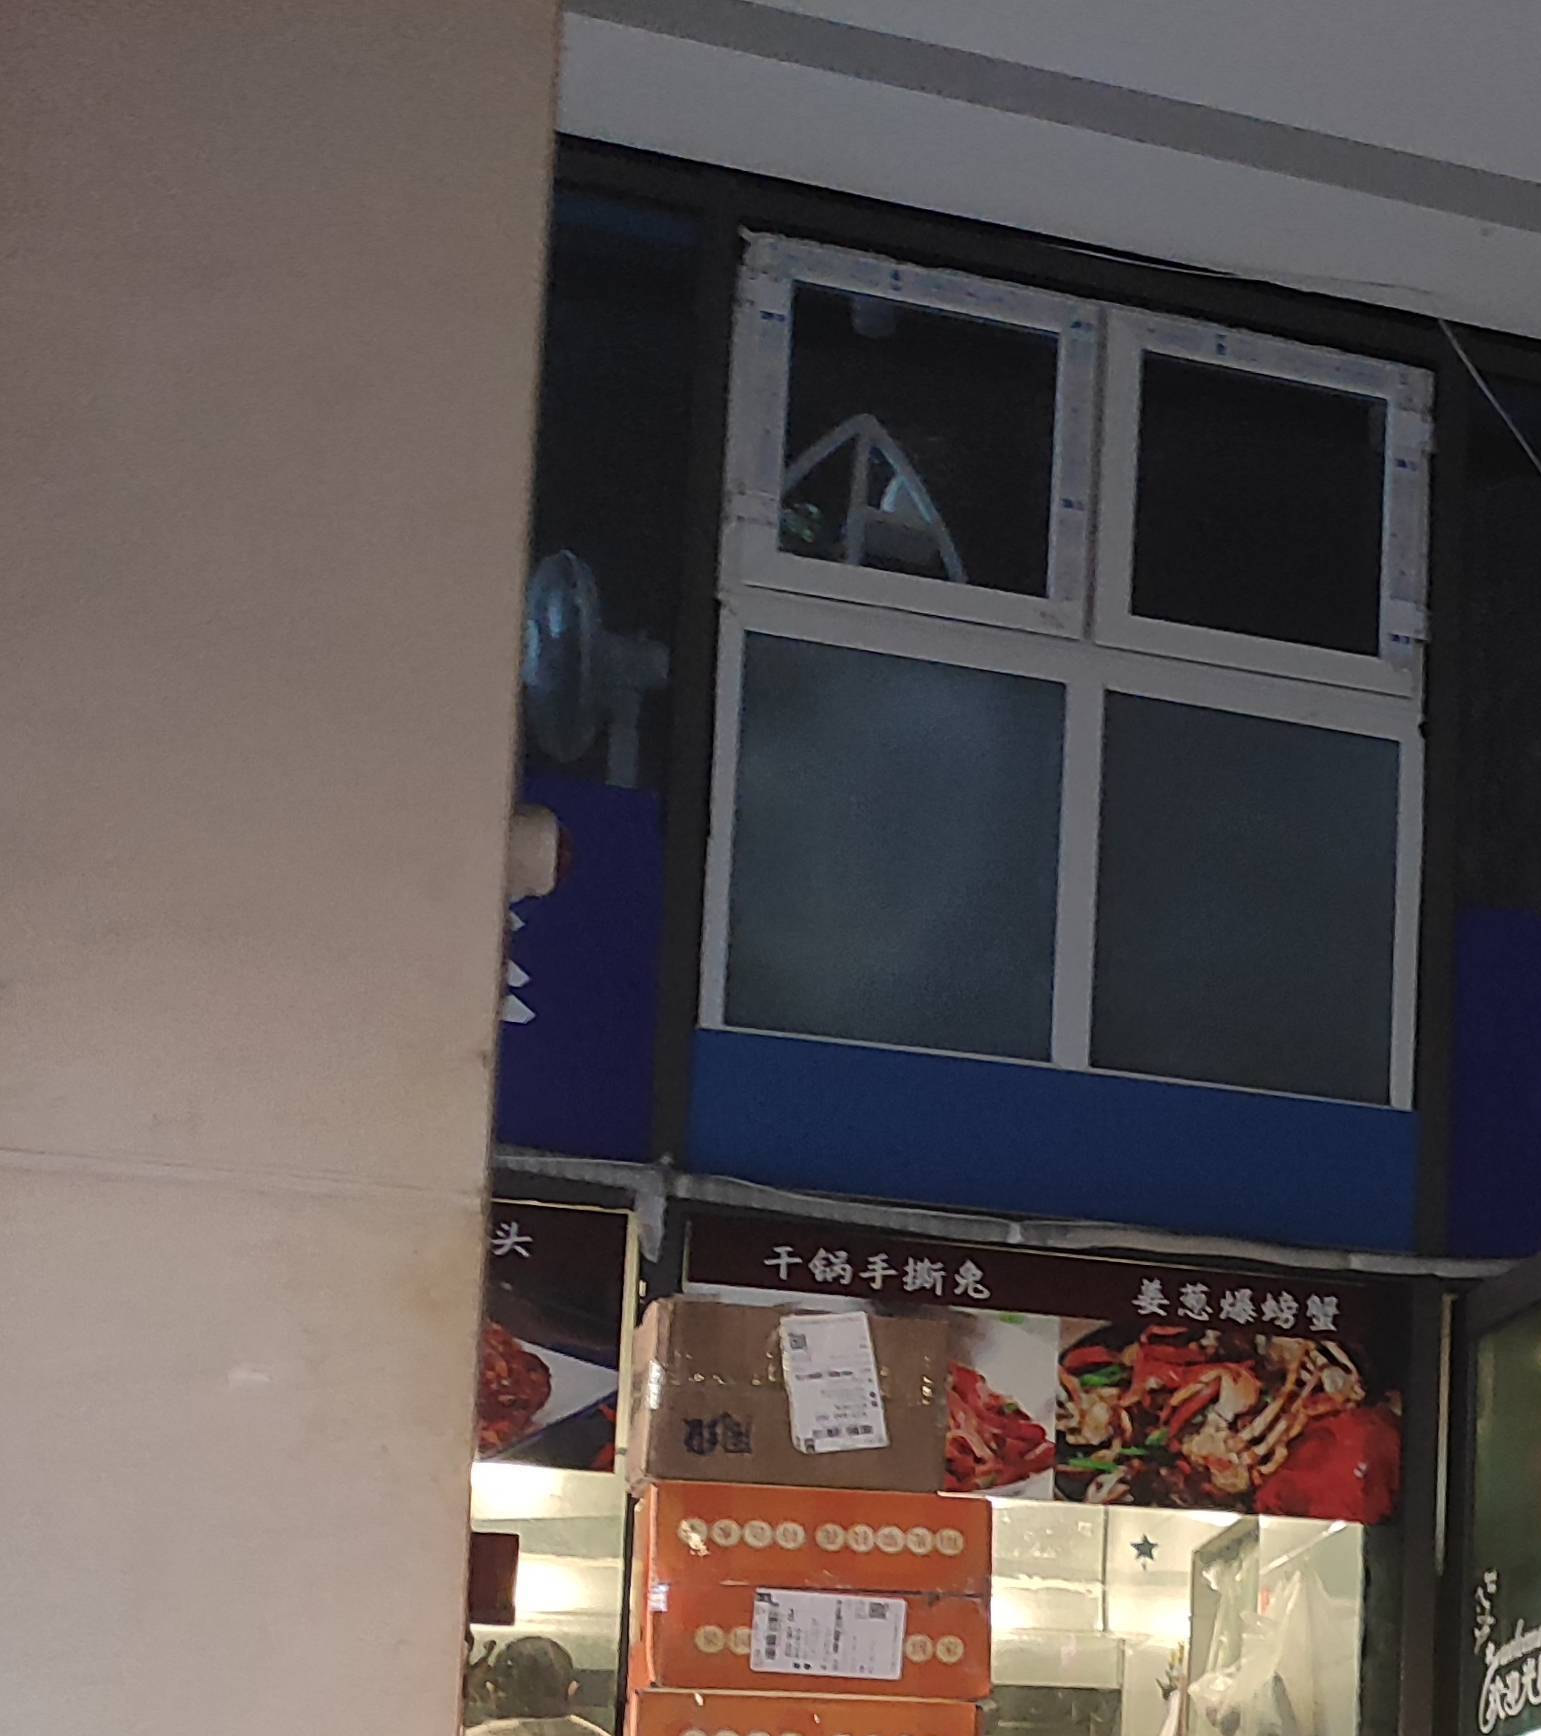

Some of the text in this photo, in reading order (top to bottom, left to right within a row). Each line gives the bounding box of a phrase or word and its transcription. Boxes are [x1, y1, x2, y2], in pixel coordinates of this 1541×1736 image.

[1131, 1277, 1341, 1332] 姜葱爆螃蟹
